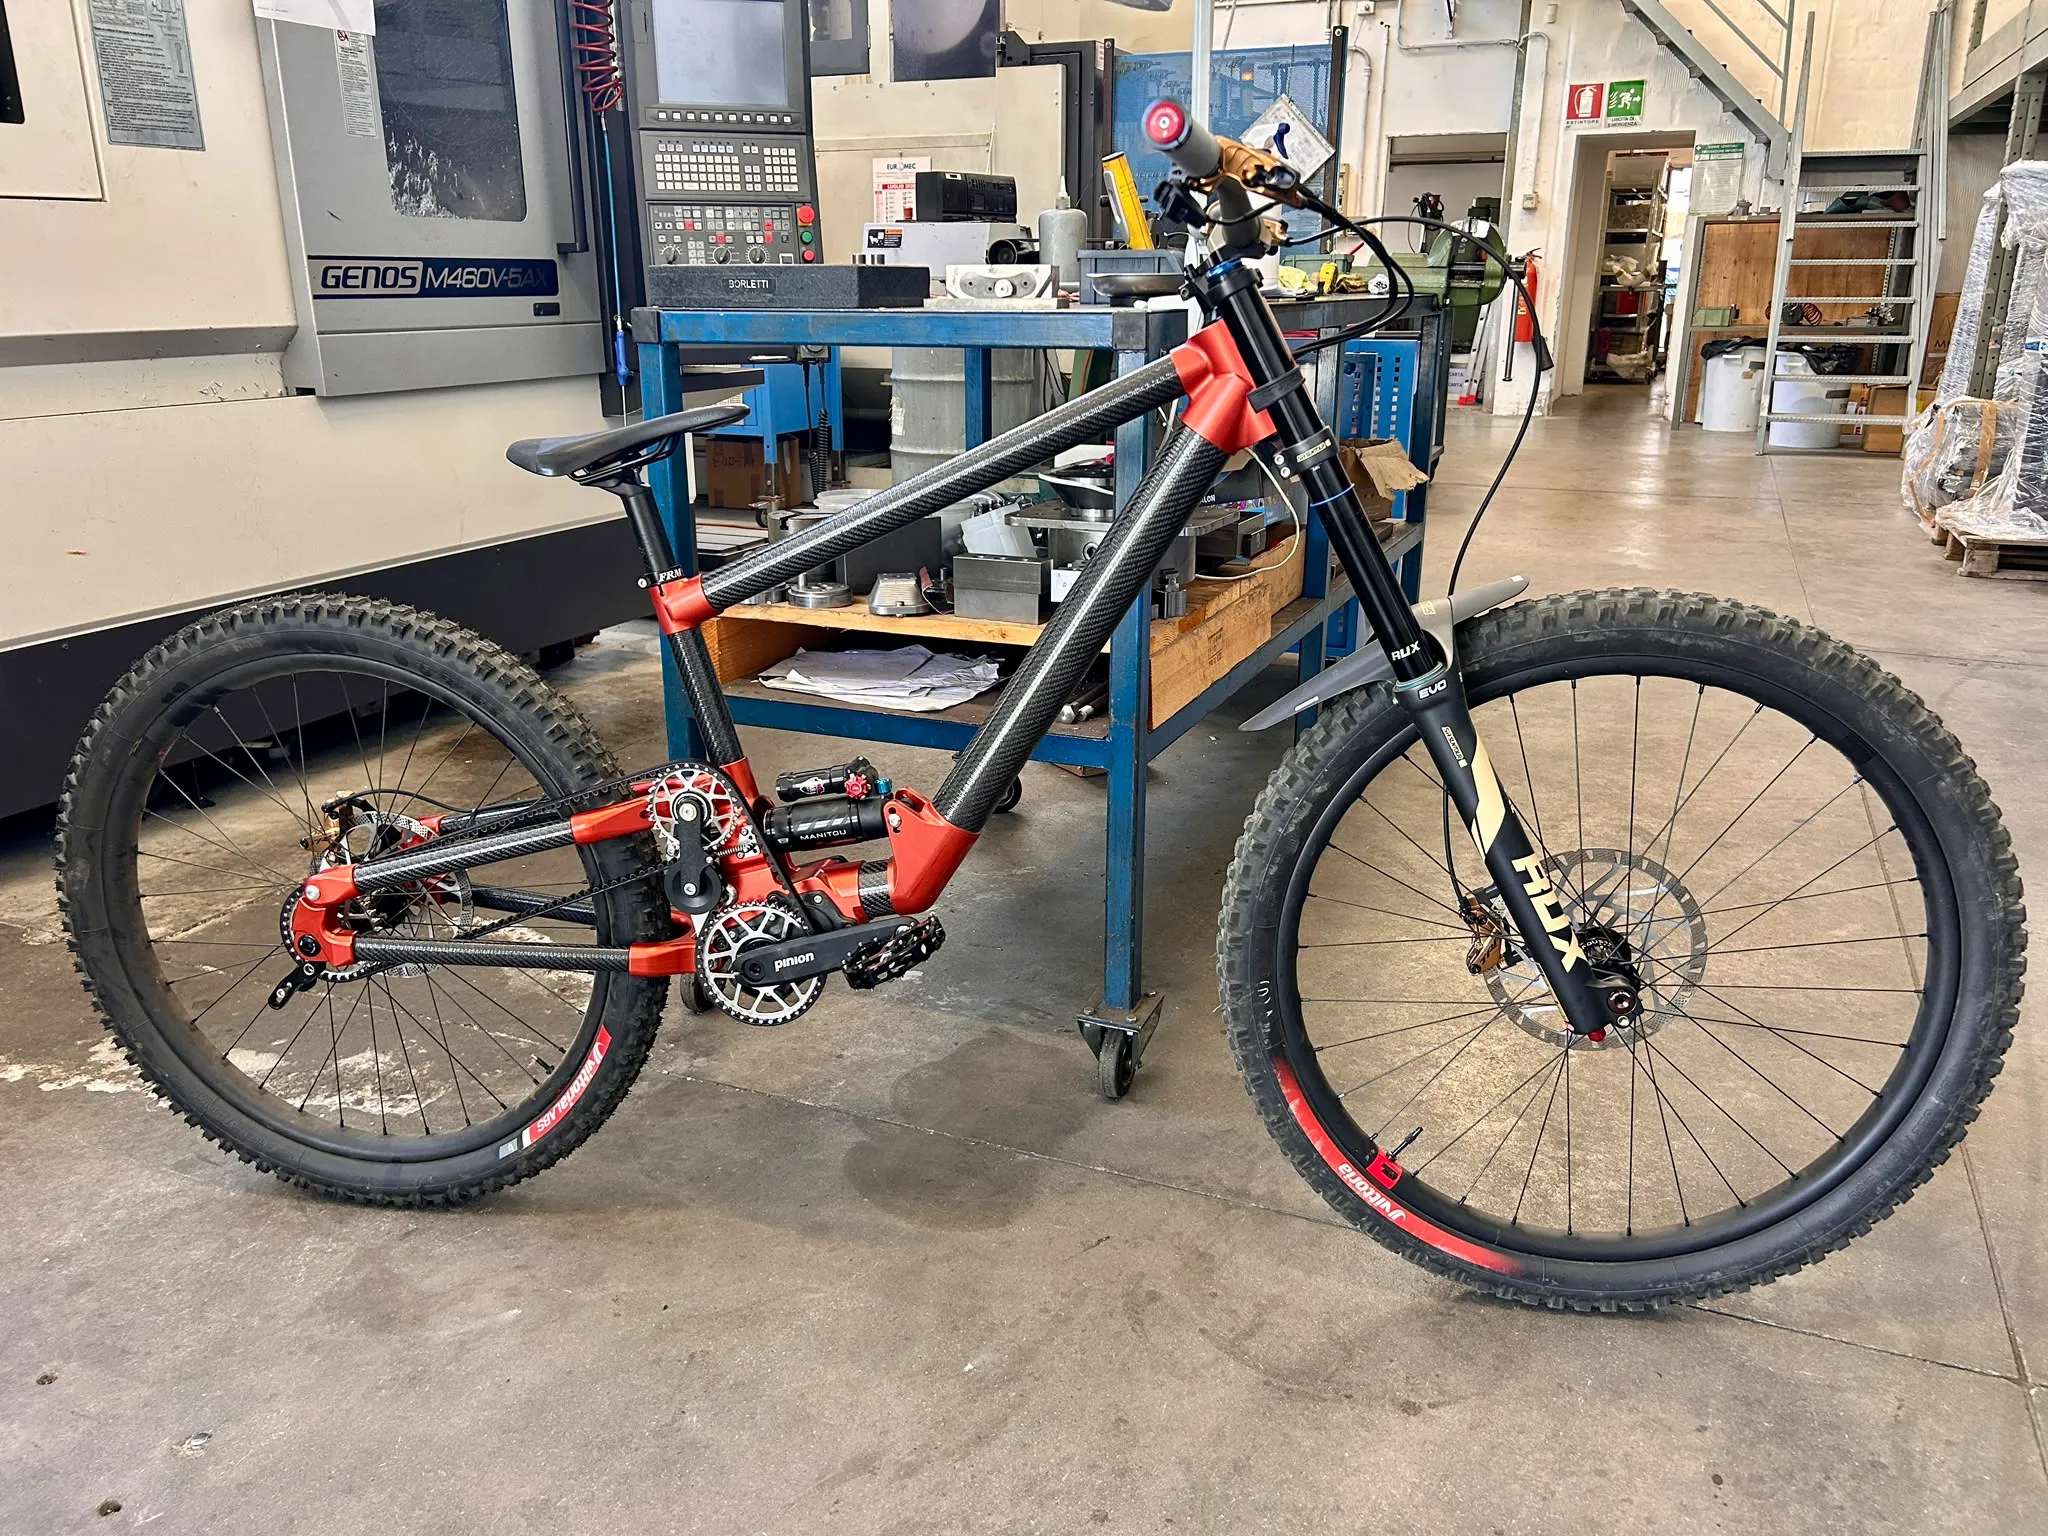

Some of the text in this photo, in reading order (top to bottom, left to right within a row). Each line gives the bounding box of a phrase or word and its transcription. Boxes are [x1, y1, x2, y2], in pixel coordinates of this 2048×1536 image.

[321, 266, 548, 289] GENOS M460V-5AX
[728, 279, 769, 289] BORLETTI
[658, 567, 685, 583] FRM
[1391, 640, 1421, 661] RUX
[1418, 679, 1447, 700] EVO
[800, 829, 847, 841] MANITOU
[1511, 853, 1588, 974] RUX
[774, 952, 815, 973] pinion
[1337, 1162, 1392, 1215] vittoria
